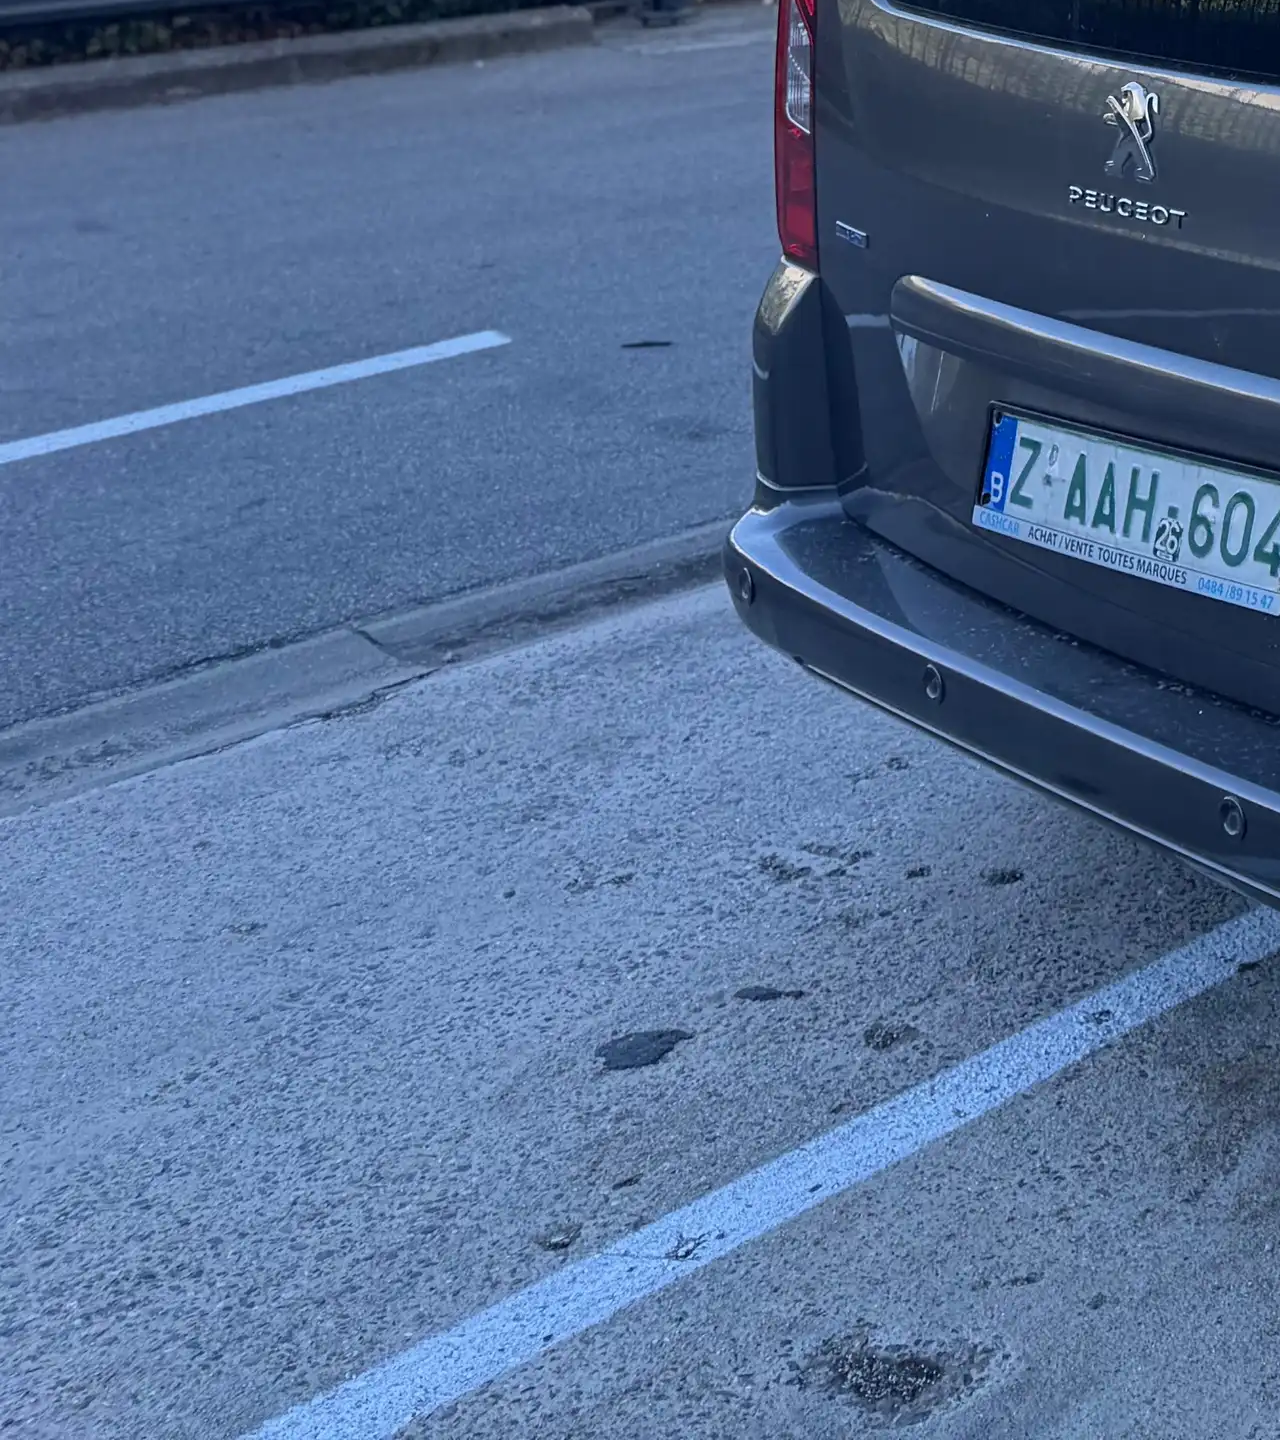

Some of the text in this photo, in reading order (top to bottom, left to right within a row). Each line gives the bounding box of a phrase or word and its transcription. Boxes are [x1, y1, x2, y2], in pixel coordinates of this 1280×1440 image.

[1069, 185, 1188, 229] PEUGEOT
[990, 470, 1004, 504] B
[1027, 526, 1058, 547] ACHAT
[1098, 547, 1135, 571] TOUTES
[1136, 558, 1188, 585] MARQUES
